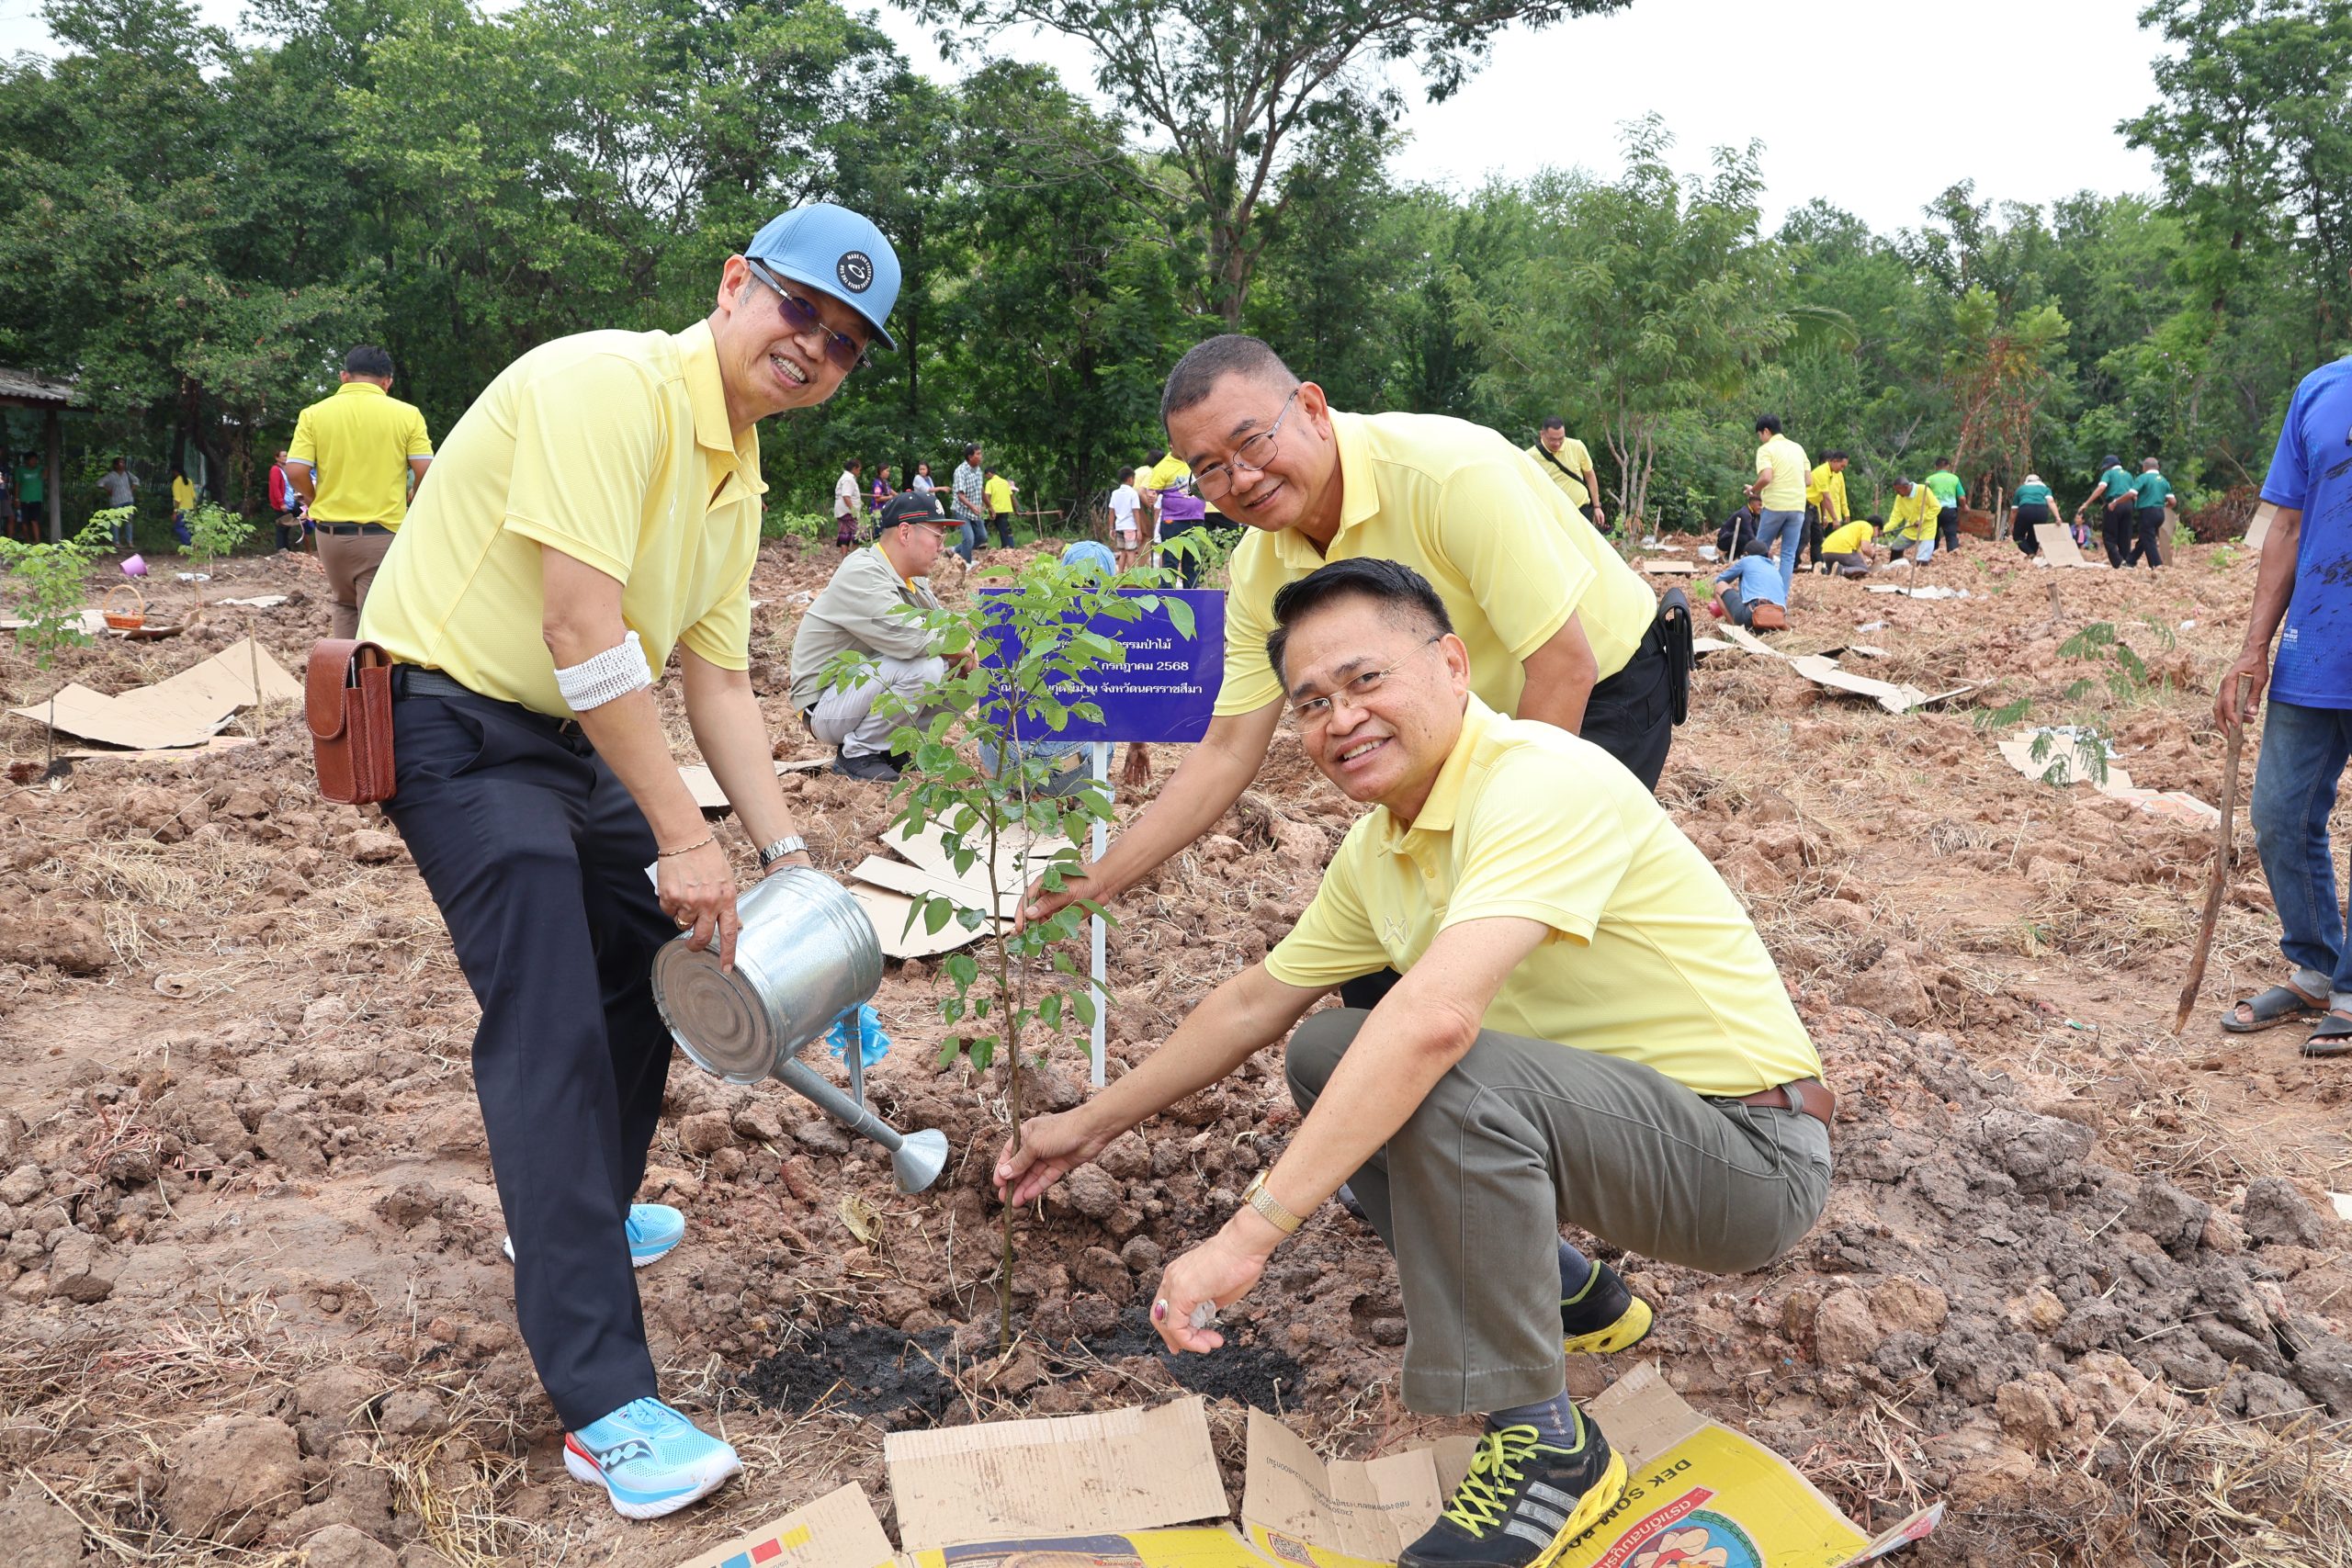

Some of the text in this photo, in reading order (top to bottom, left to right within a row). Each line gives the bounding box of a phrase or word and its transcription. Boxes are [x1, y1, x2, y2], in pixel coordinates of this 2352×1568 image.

[1102, 661, 1154, 673] กรกฎาคม
[1156, 661, 1190, 671] 2568
[1101, 682, 1203, 694] จังหวัดนครราชสีมา
[1646, 1459, 1692, 1488] DEK
[1600, 1486, 1645, 1527] SOM
